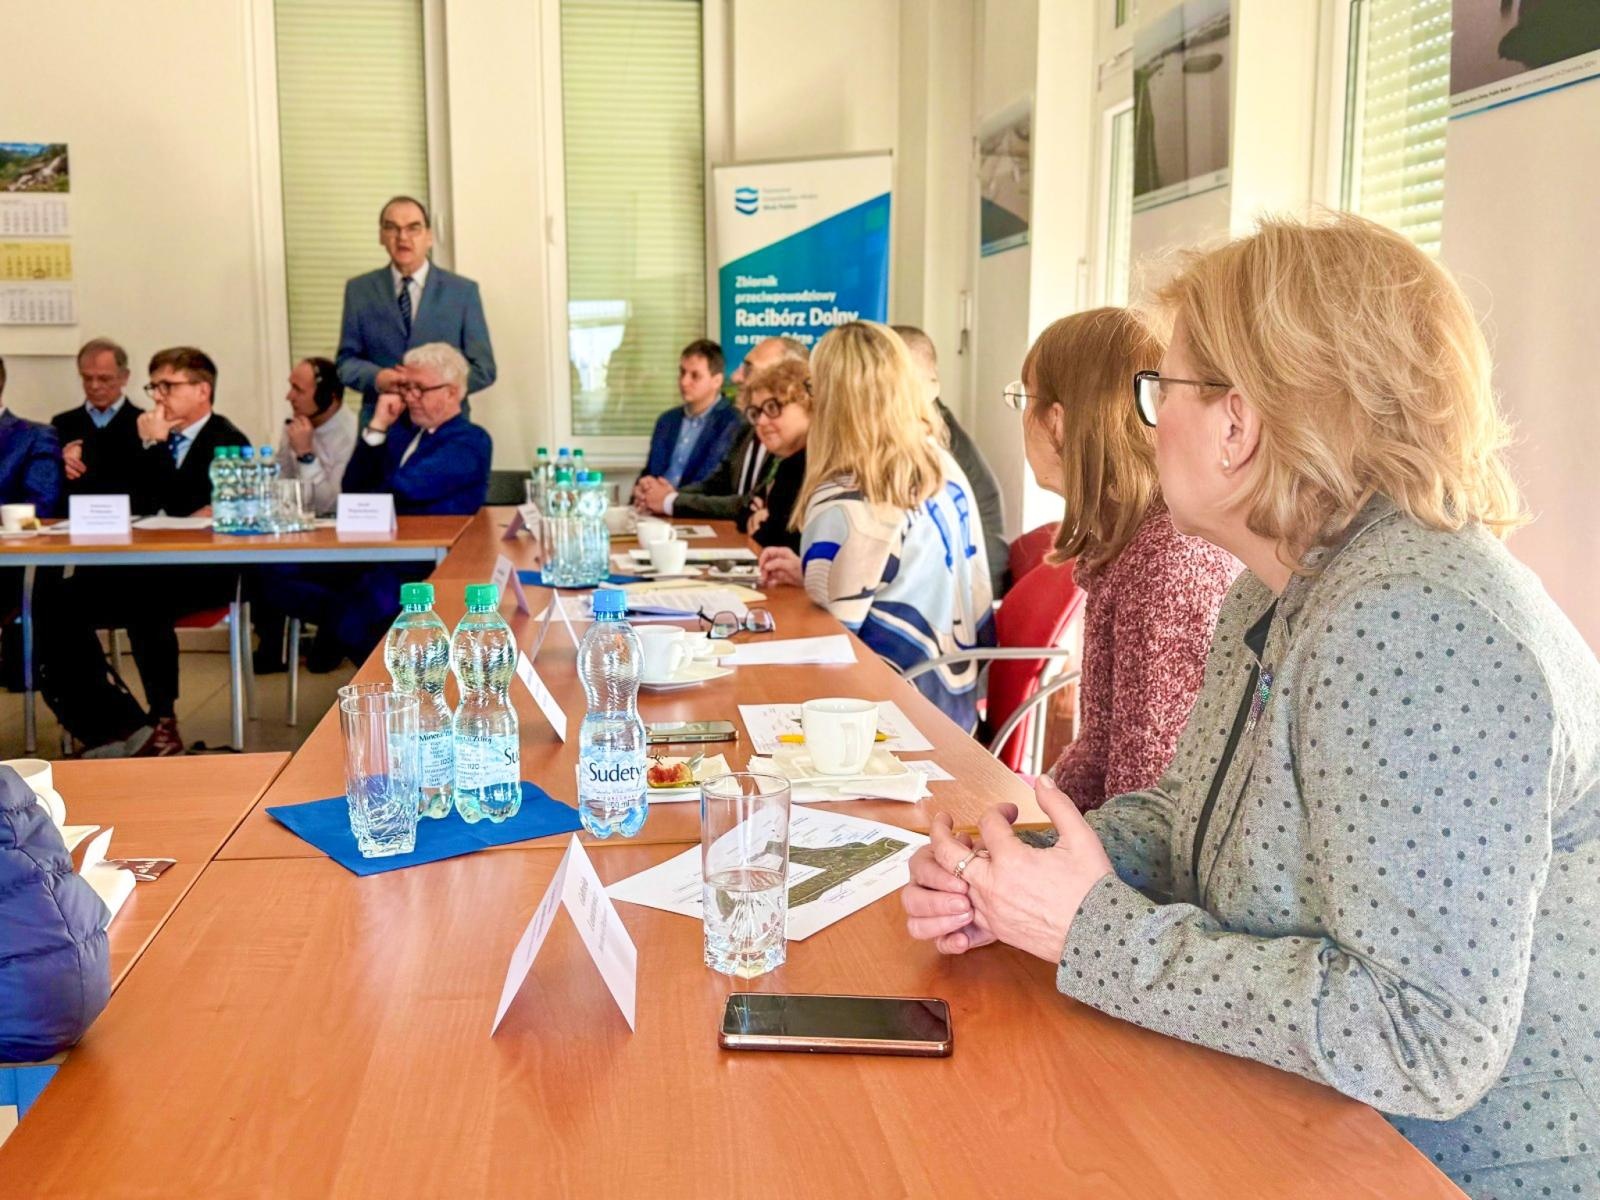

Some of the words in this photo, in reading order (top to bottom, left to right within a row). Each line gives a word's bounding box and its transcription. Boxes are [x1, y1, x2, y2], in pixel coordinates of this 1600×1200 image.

[735, 307, 806, 327] Racibórz
[808, 306, 859, 326] Dolny
[588, 762, 647, 789] Sudety
